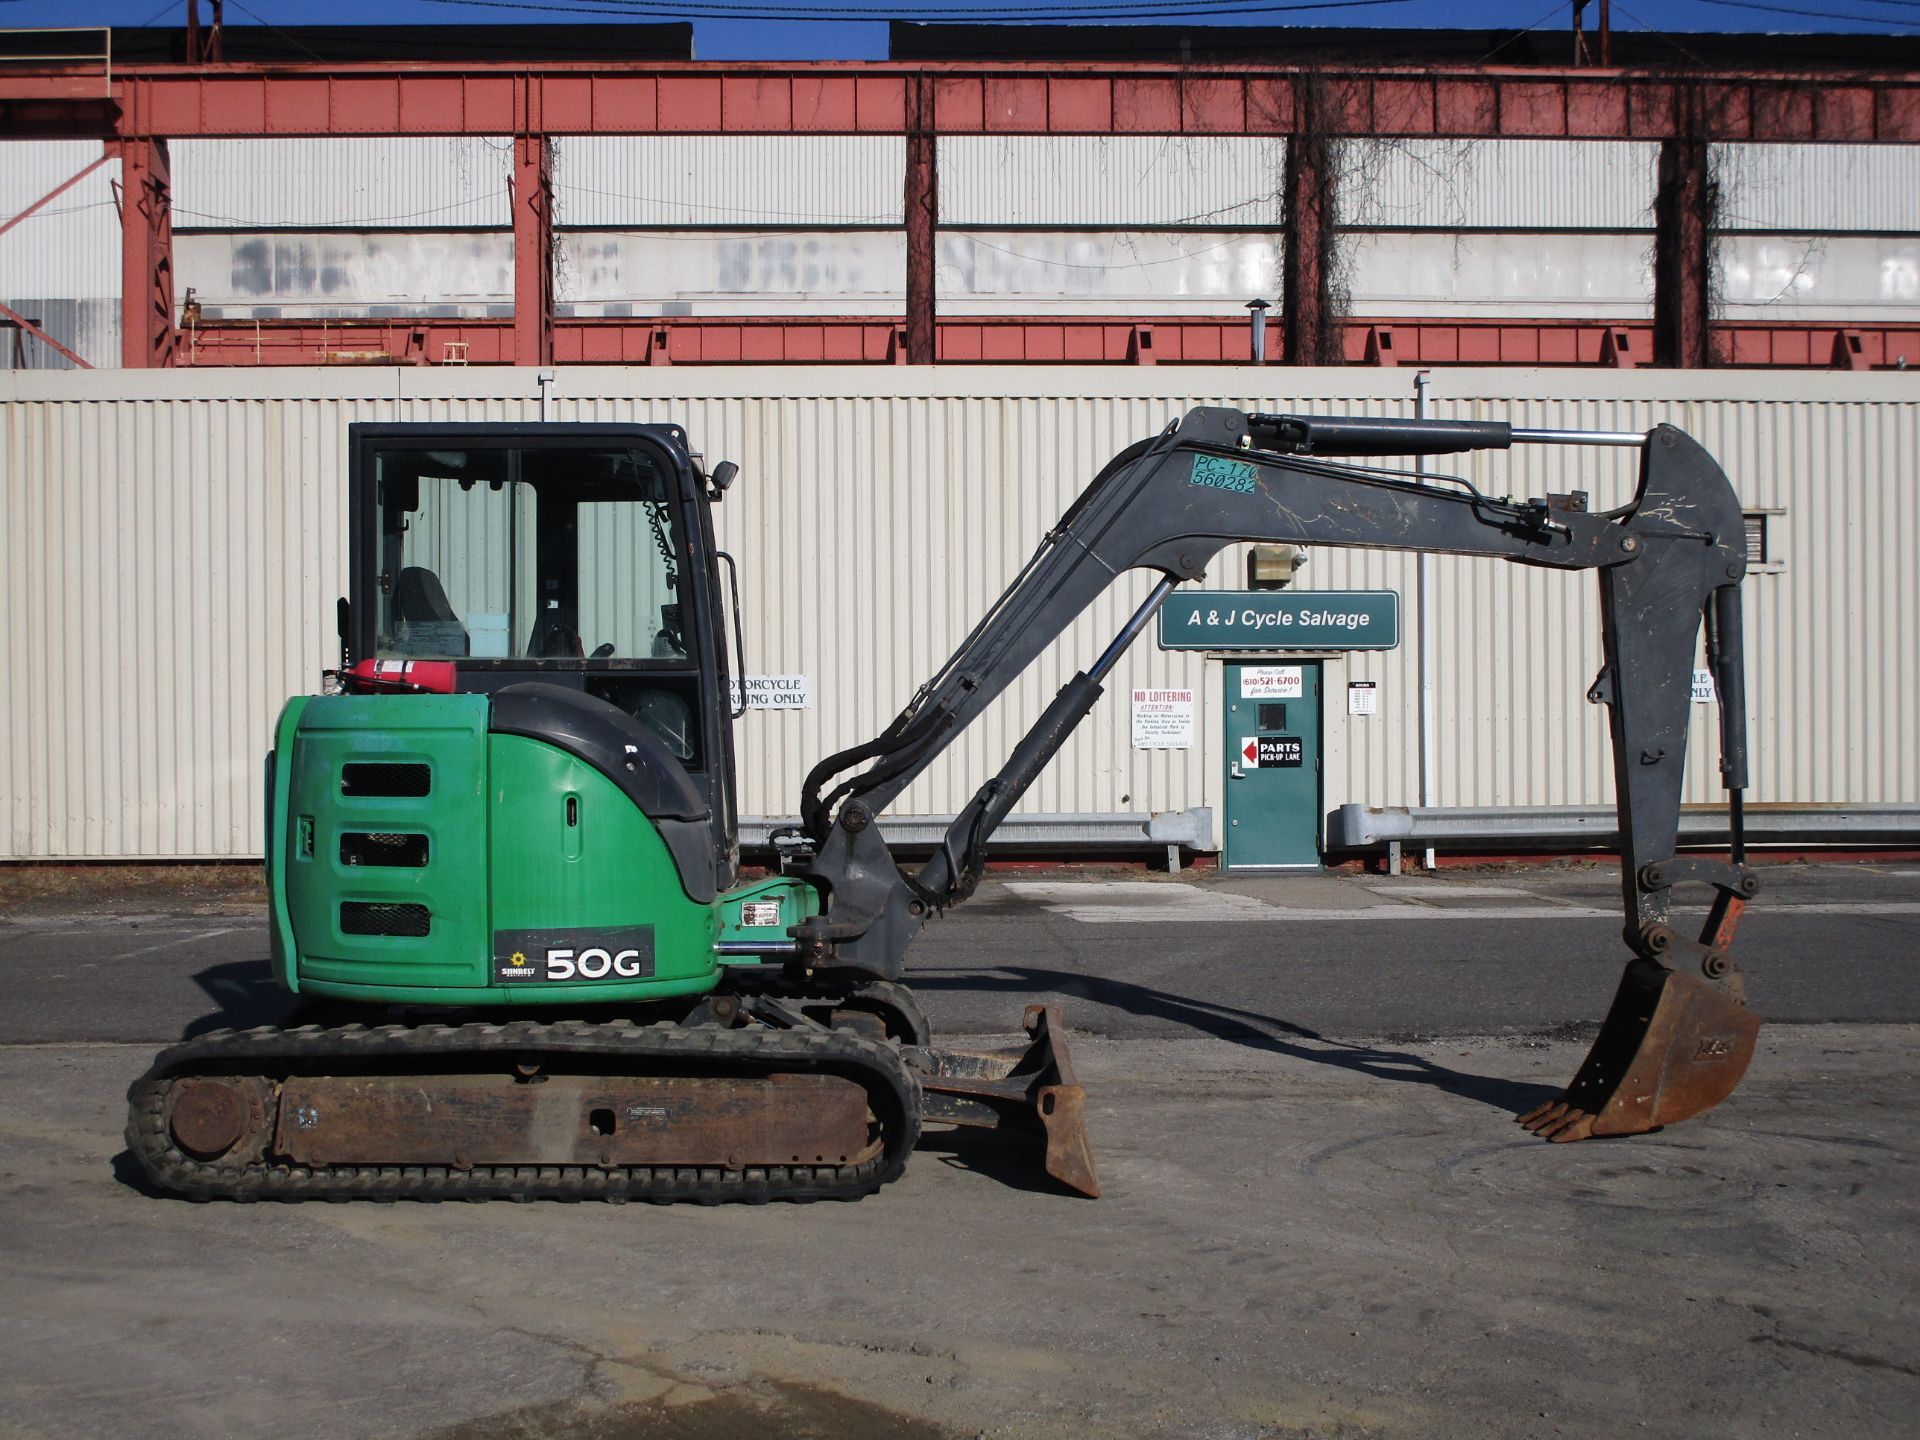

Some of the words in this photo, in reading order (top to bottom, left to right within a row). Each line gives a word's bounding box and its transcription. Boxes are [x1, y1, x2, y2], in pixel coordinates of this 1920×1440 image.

[1192, 470, 1256, 494] 560282
[1187, 610, 1201, 626] A
[1206, 610, 1219, 626] &
[1224, 610, 1236, 626] J
[1241, 610, 1293, 630] Cycle
[1298, 610, 1370, 630] Salvage
[729, 679, 801, 690] OTORCYCLE
[1134, 691, 1146, 702] NO
[1149, 691, 1192, 702] LOITERING
[1250, 687, 1262, 696] for
[1691, 687, 1712, 698] NLY
[774, 693, 806, 704] ONLY
[1260, 743, 1301, 753] PARTS
[1260, 753, 1284, 761] PICK-UP
[1285, 753, 1301, 761] LANE
[547, 948, 640, 980] 50G
